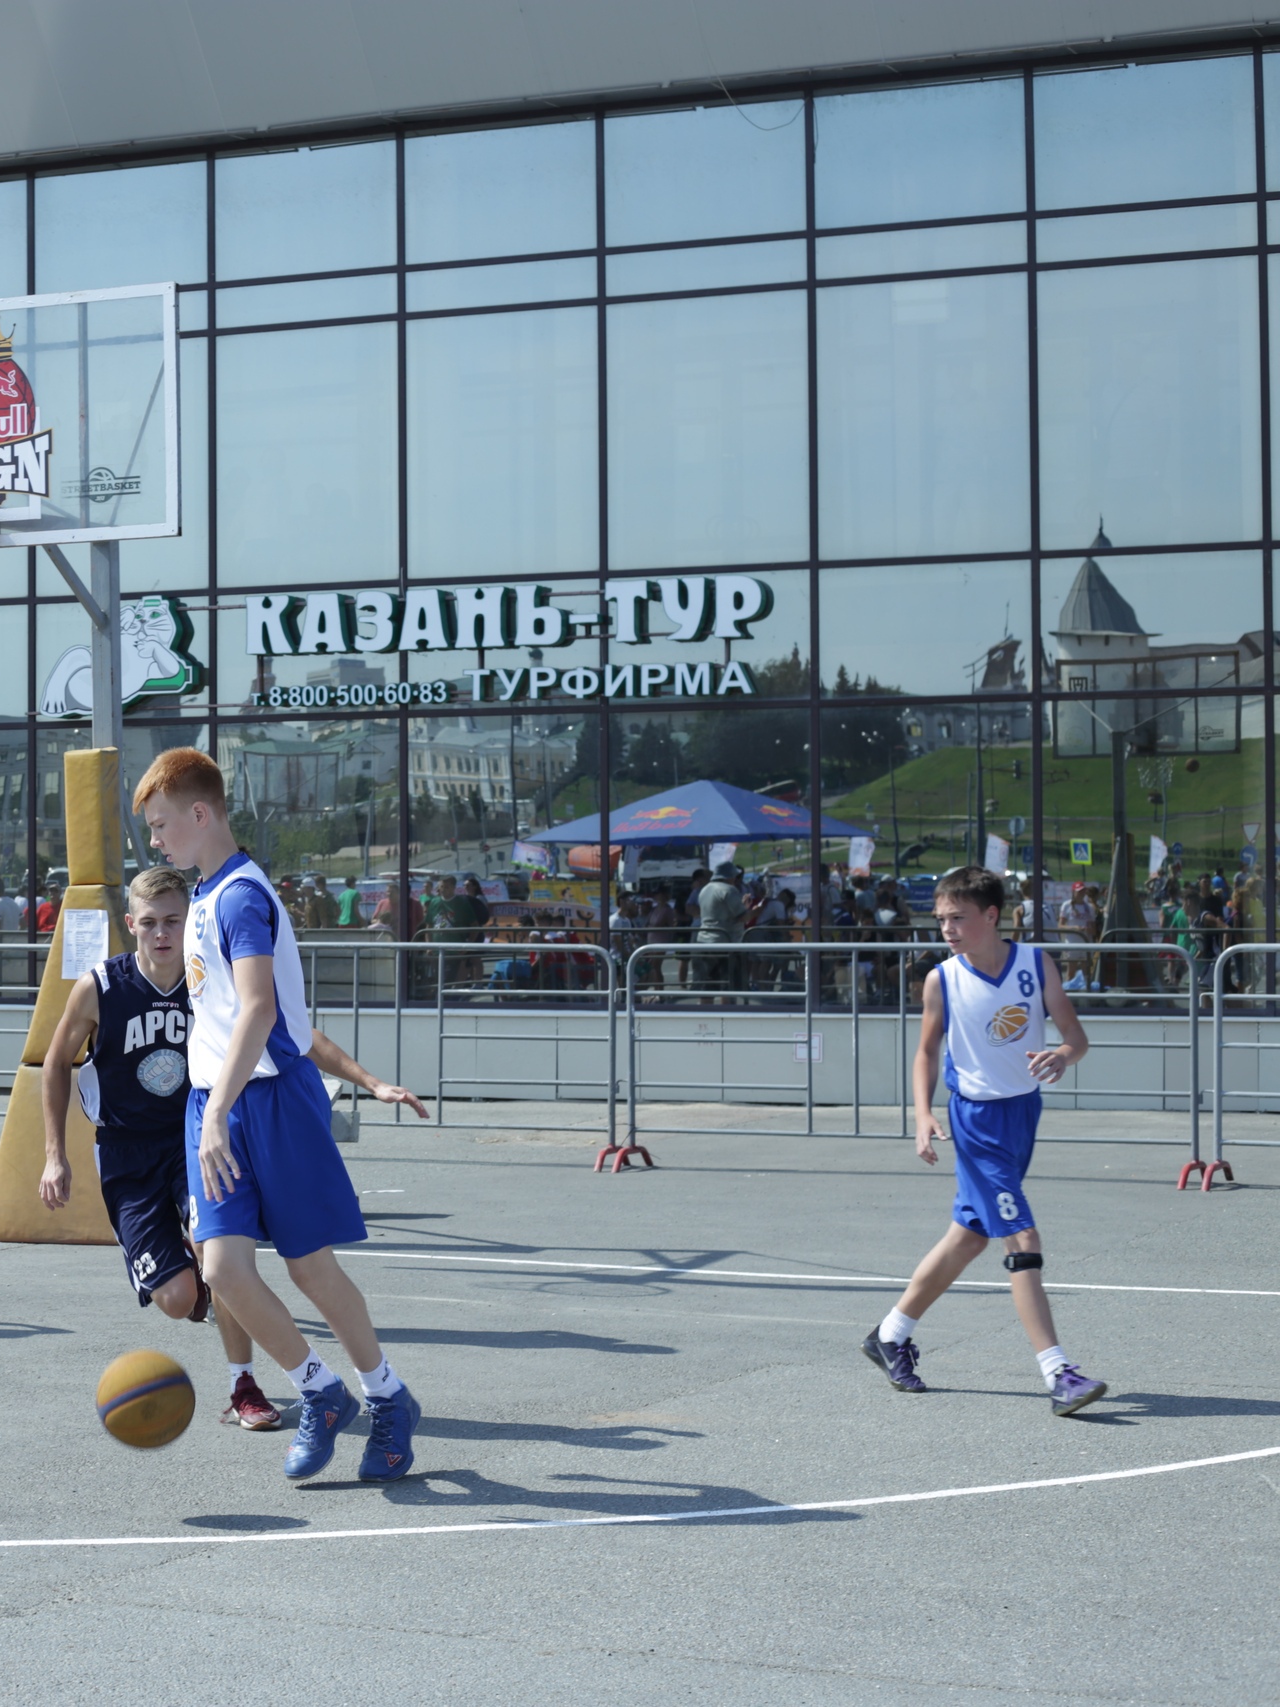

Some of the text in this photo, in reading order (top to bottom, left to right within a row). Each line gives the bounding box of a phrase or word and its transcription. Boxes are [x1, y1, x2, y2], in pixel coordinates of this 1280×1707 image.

[61, 481, 141, 494] STREETBASKET
[246, 575, 766, 656] КАЗАНЬ-ТУР
[463, 661, 754, 700] ТУРФИРМА
[195, 908, 206, 939] 9
[1017, 969, 1035, 998] 8
[996, 1192, 1018, 1221] 8
